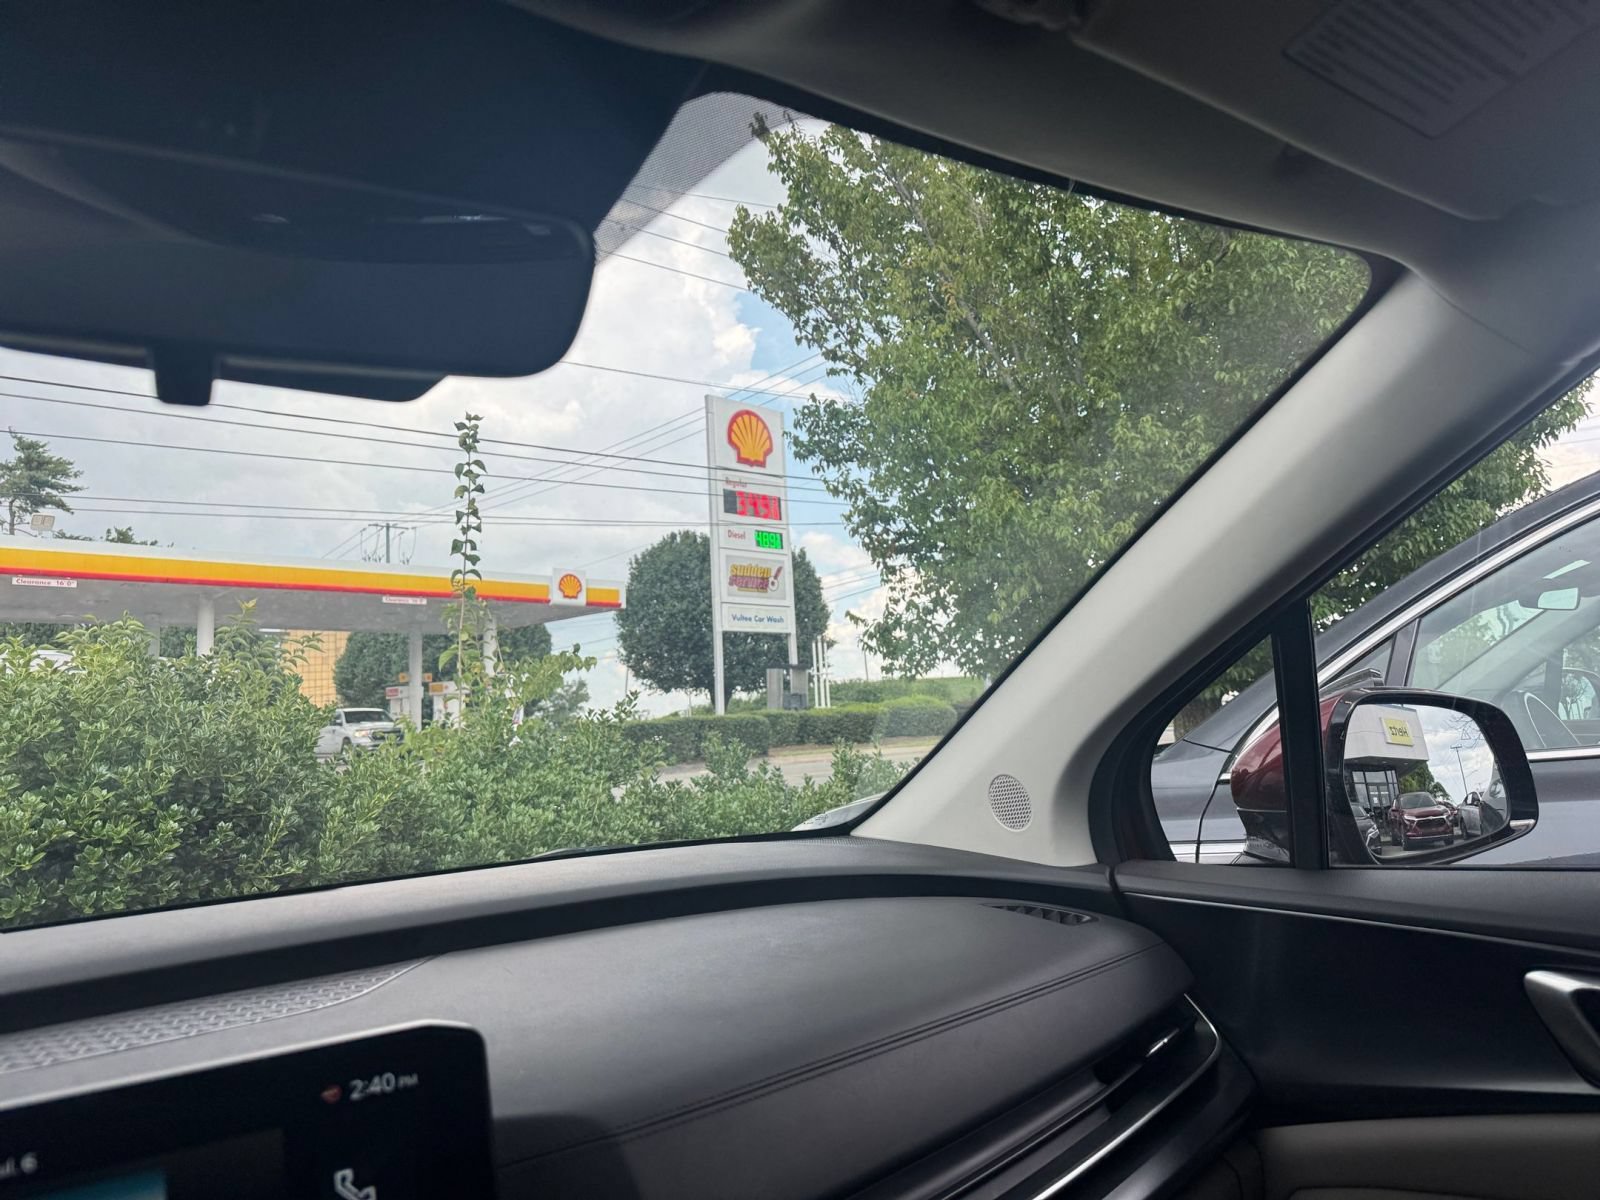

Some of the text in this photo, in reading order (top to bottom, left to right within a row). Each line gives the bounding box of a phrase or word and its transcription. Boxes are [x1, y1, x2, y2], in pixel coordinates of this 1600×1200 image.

[728, 529, 746, 540] Diesel
[731, 613, 785, 624] Vultee Car Wash
[348, 1072, 396, 1101] 2:40
